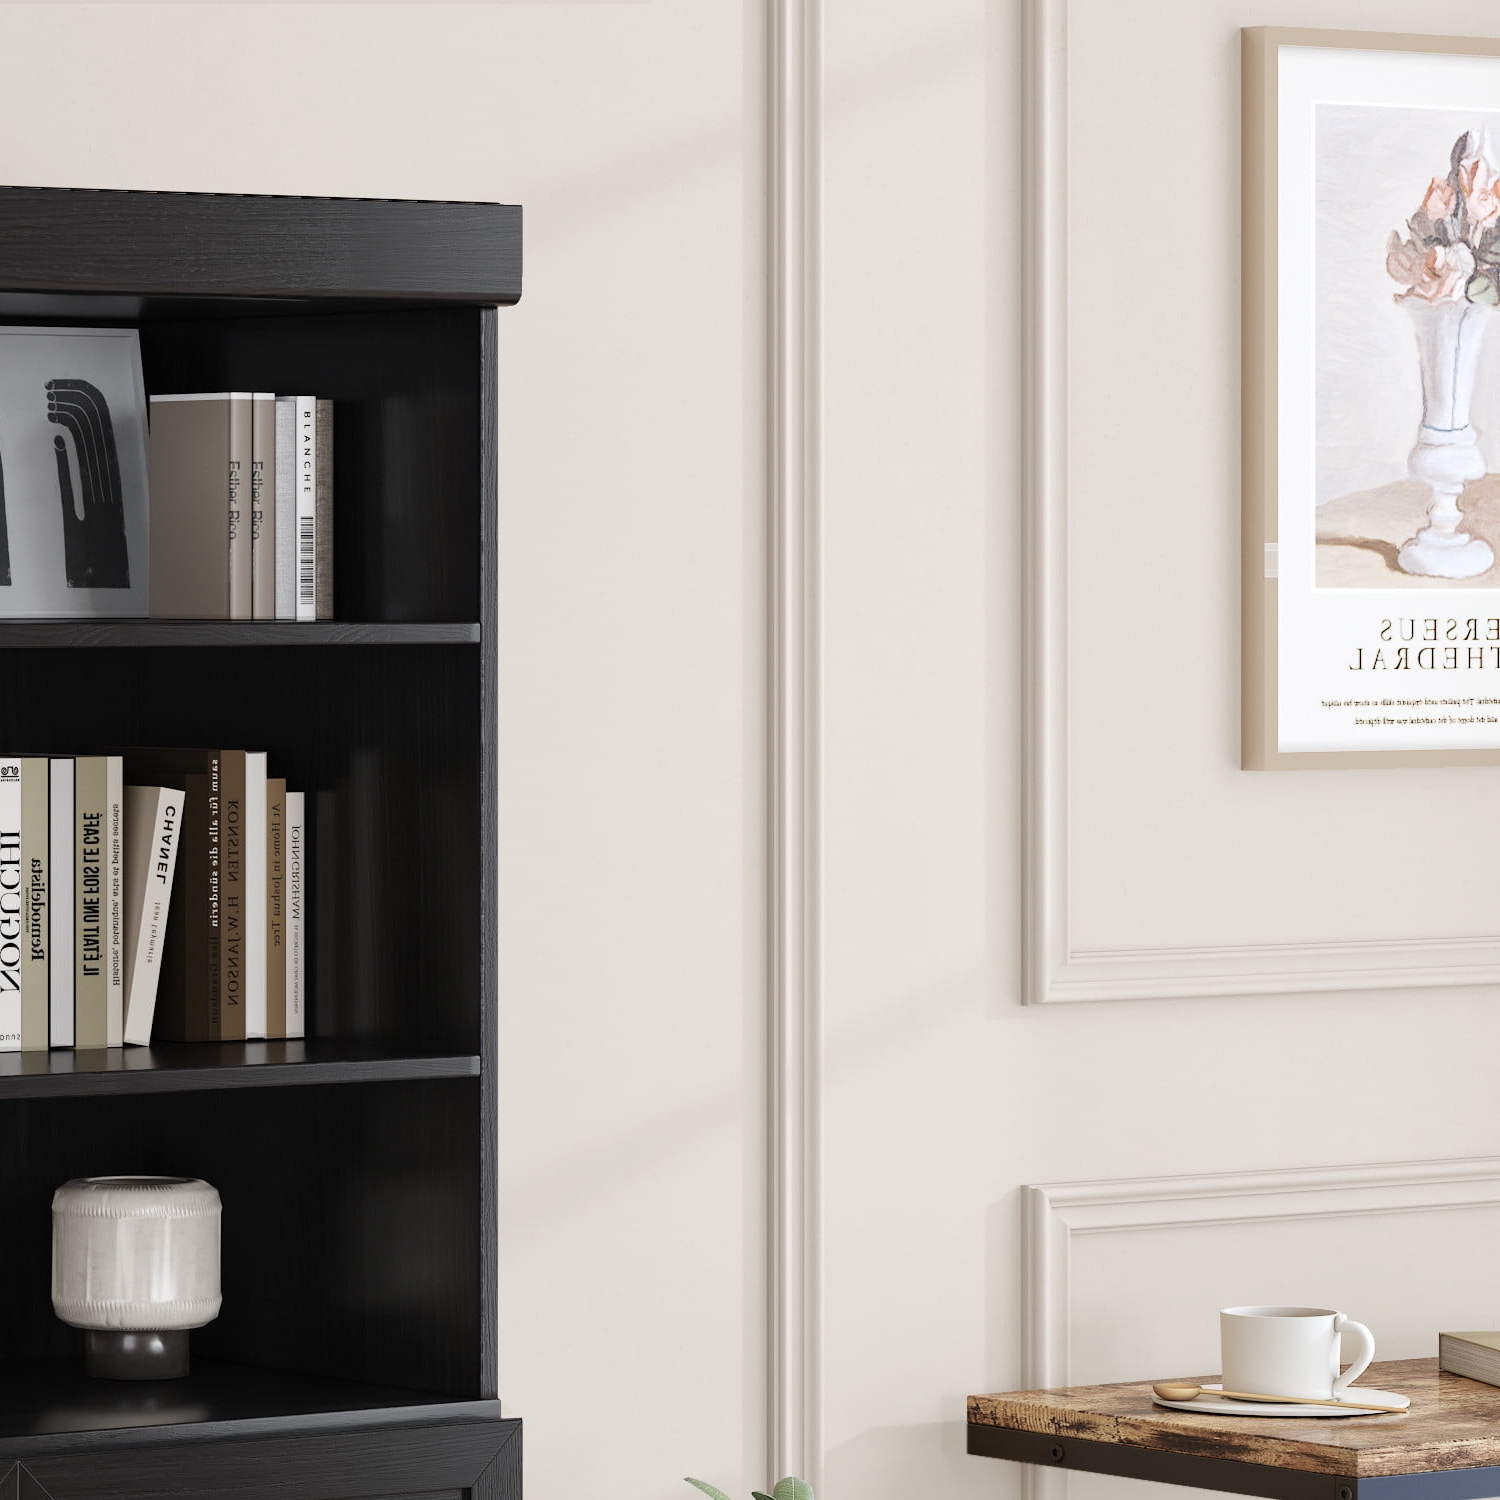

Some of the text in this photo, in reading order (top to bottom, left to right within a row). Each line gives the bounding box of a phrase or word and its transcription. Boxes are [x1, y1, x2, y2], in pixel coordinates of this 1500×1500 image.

[229, 461, 241, 540] Esther Rico
[252, 461, 264, 540] Esther Rico
